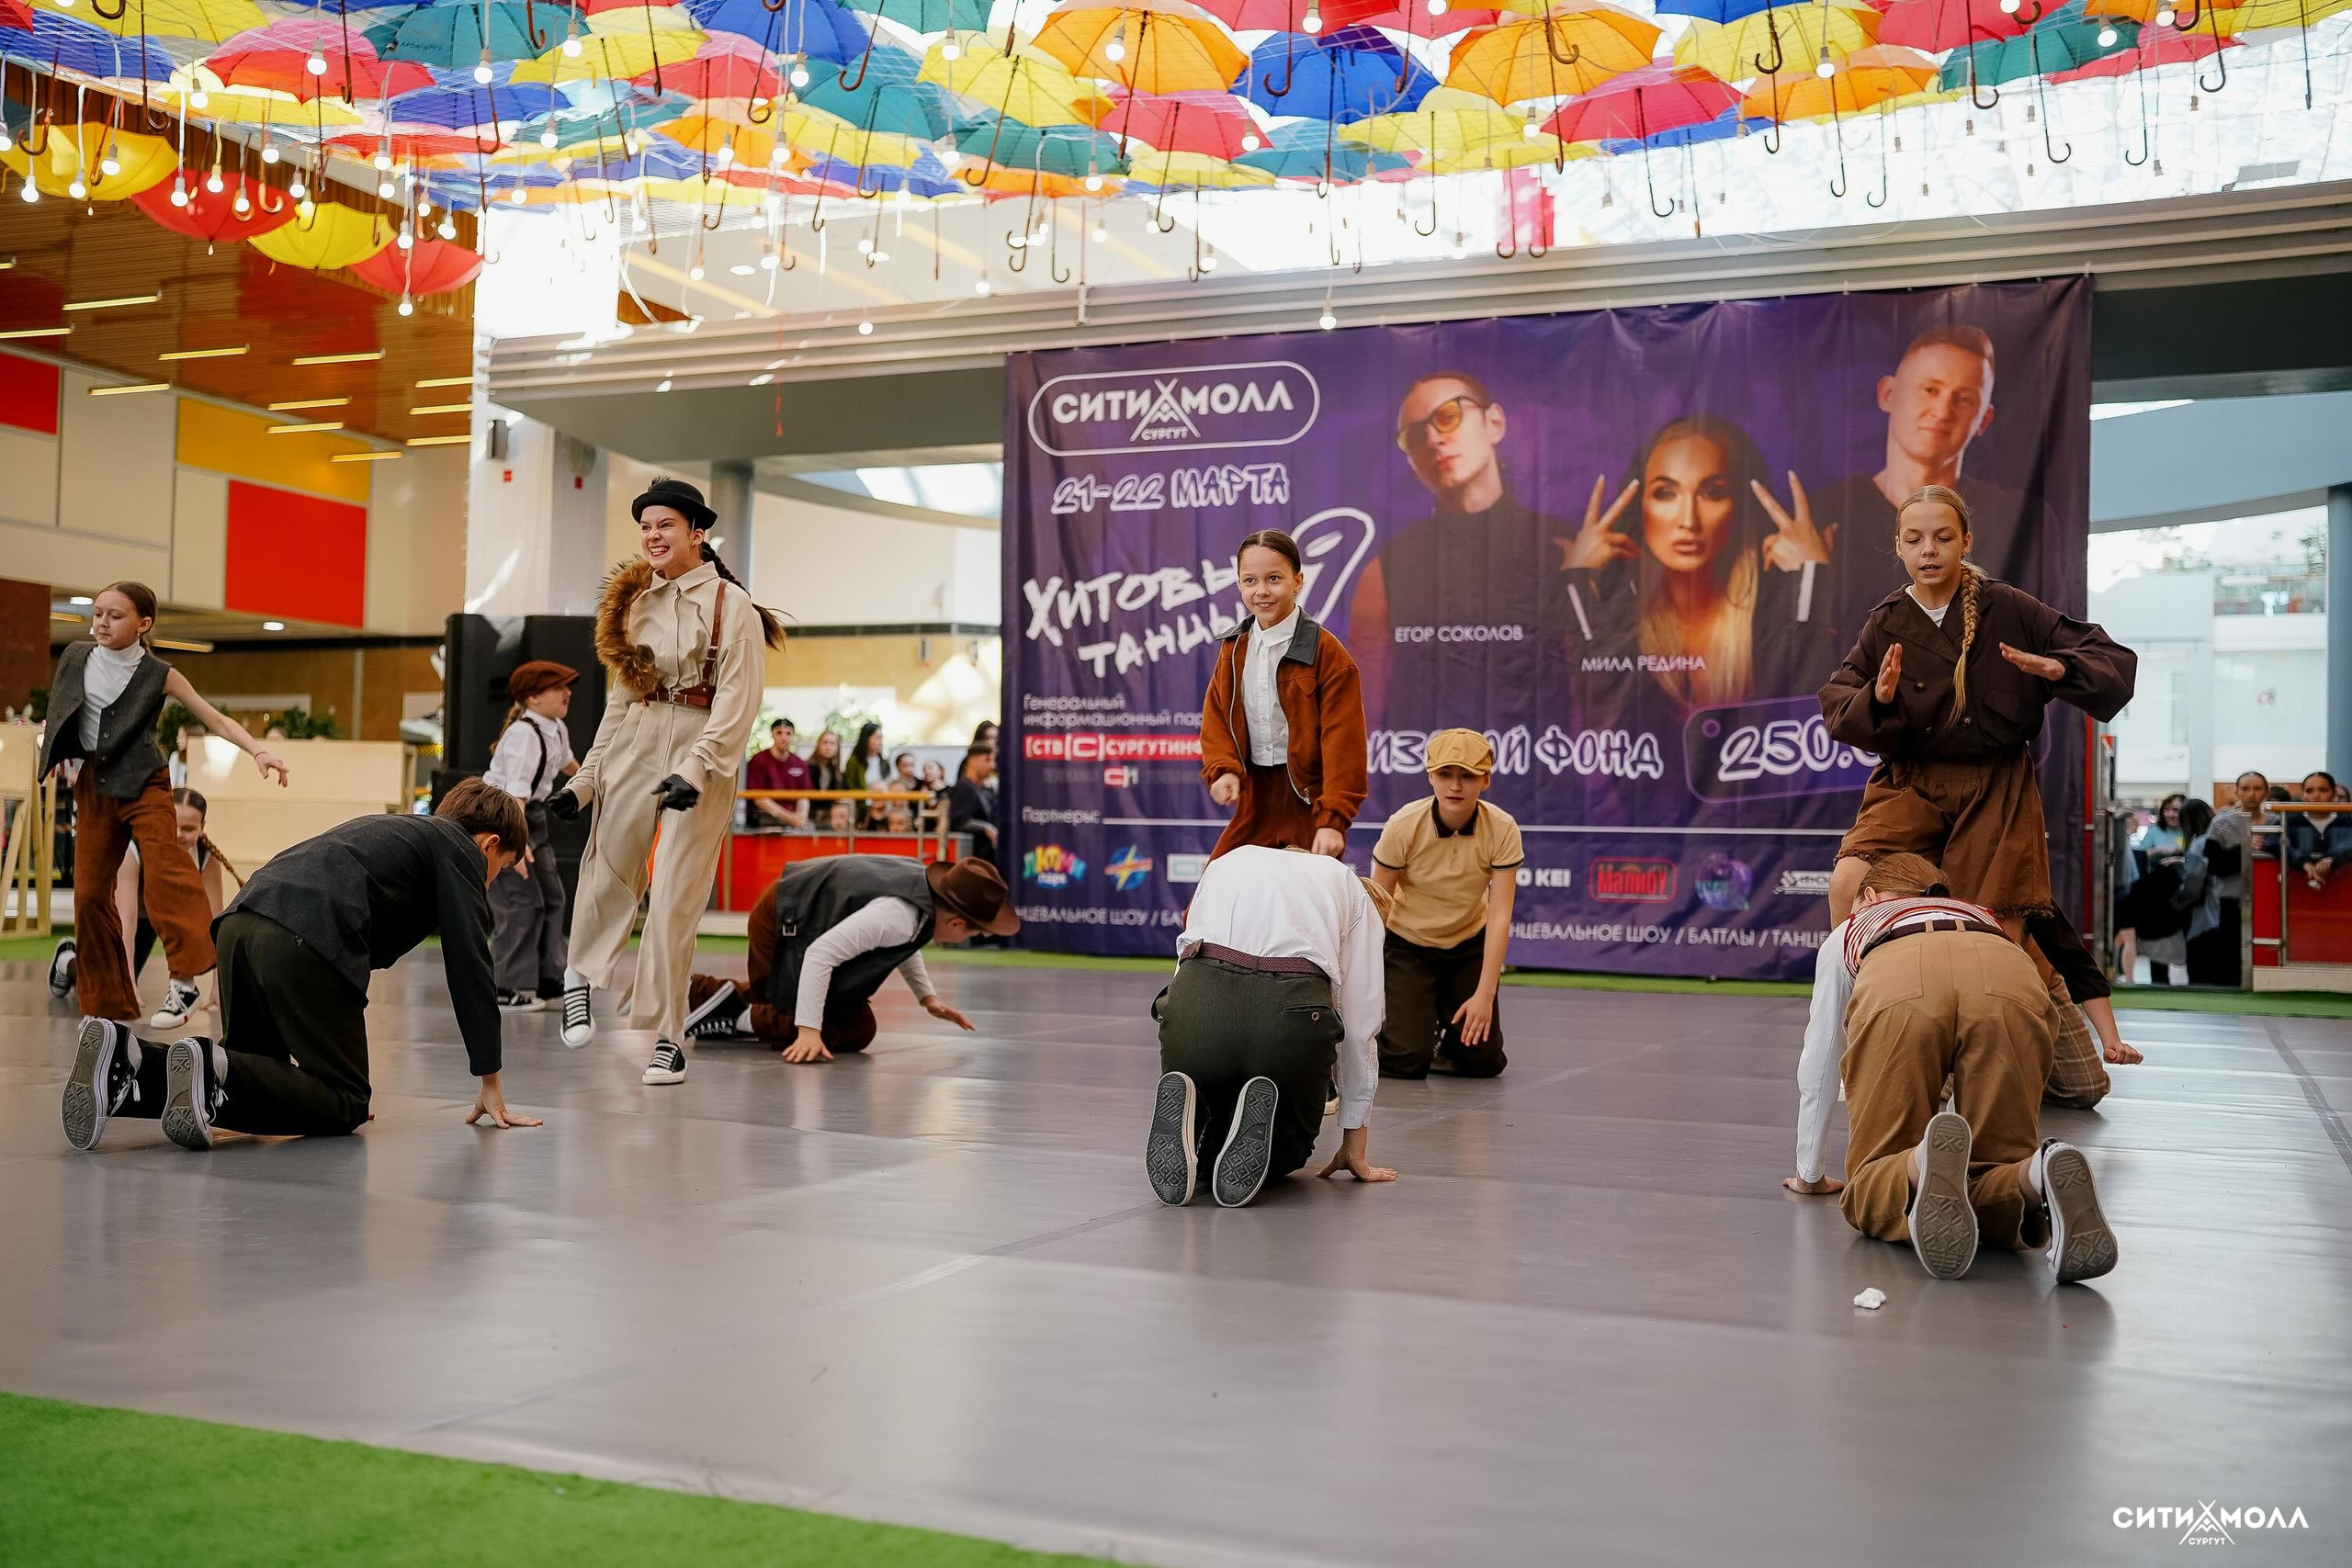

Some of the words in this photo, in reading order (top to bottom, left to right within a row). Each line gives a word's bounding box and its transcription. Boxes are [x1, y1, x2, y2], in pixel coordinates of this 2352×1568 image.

[1141, 426, 1189, 441] СУРГУТ
[1051, 473, 1166, 514] 21-22
[1170, 462, 1290, 508] МАРТА
[1023, 555, 1238, 647] ХИТОВЫ
[1395, 626, 1435, 643] ЕГОР
[1437, 624, 1524, 642] СОКОЛОВ
[1581, 656, 1634, 671] МИЛА
[1637, 654, 1706, 671] РЕДИНА
[1023, 693, 1125, 711] Генеральный
[1534, 724, 1665, 781] ФОНД
[1015, 906, 1107, 925] НЦЕВАЛЬНОЕ
[1110, 908, 1148, 926] ШОУ
[1509, 921, 1623, 942] НЦЕВАЛЬНОЕ
[1625, 924, 1672, 943] ШОУ
[1688, 927, 1755, 946] БАТТЛЫ
[1771, 930, 1831, 949] ТАНЦЕ
